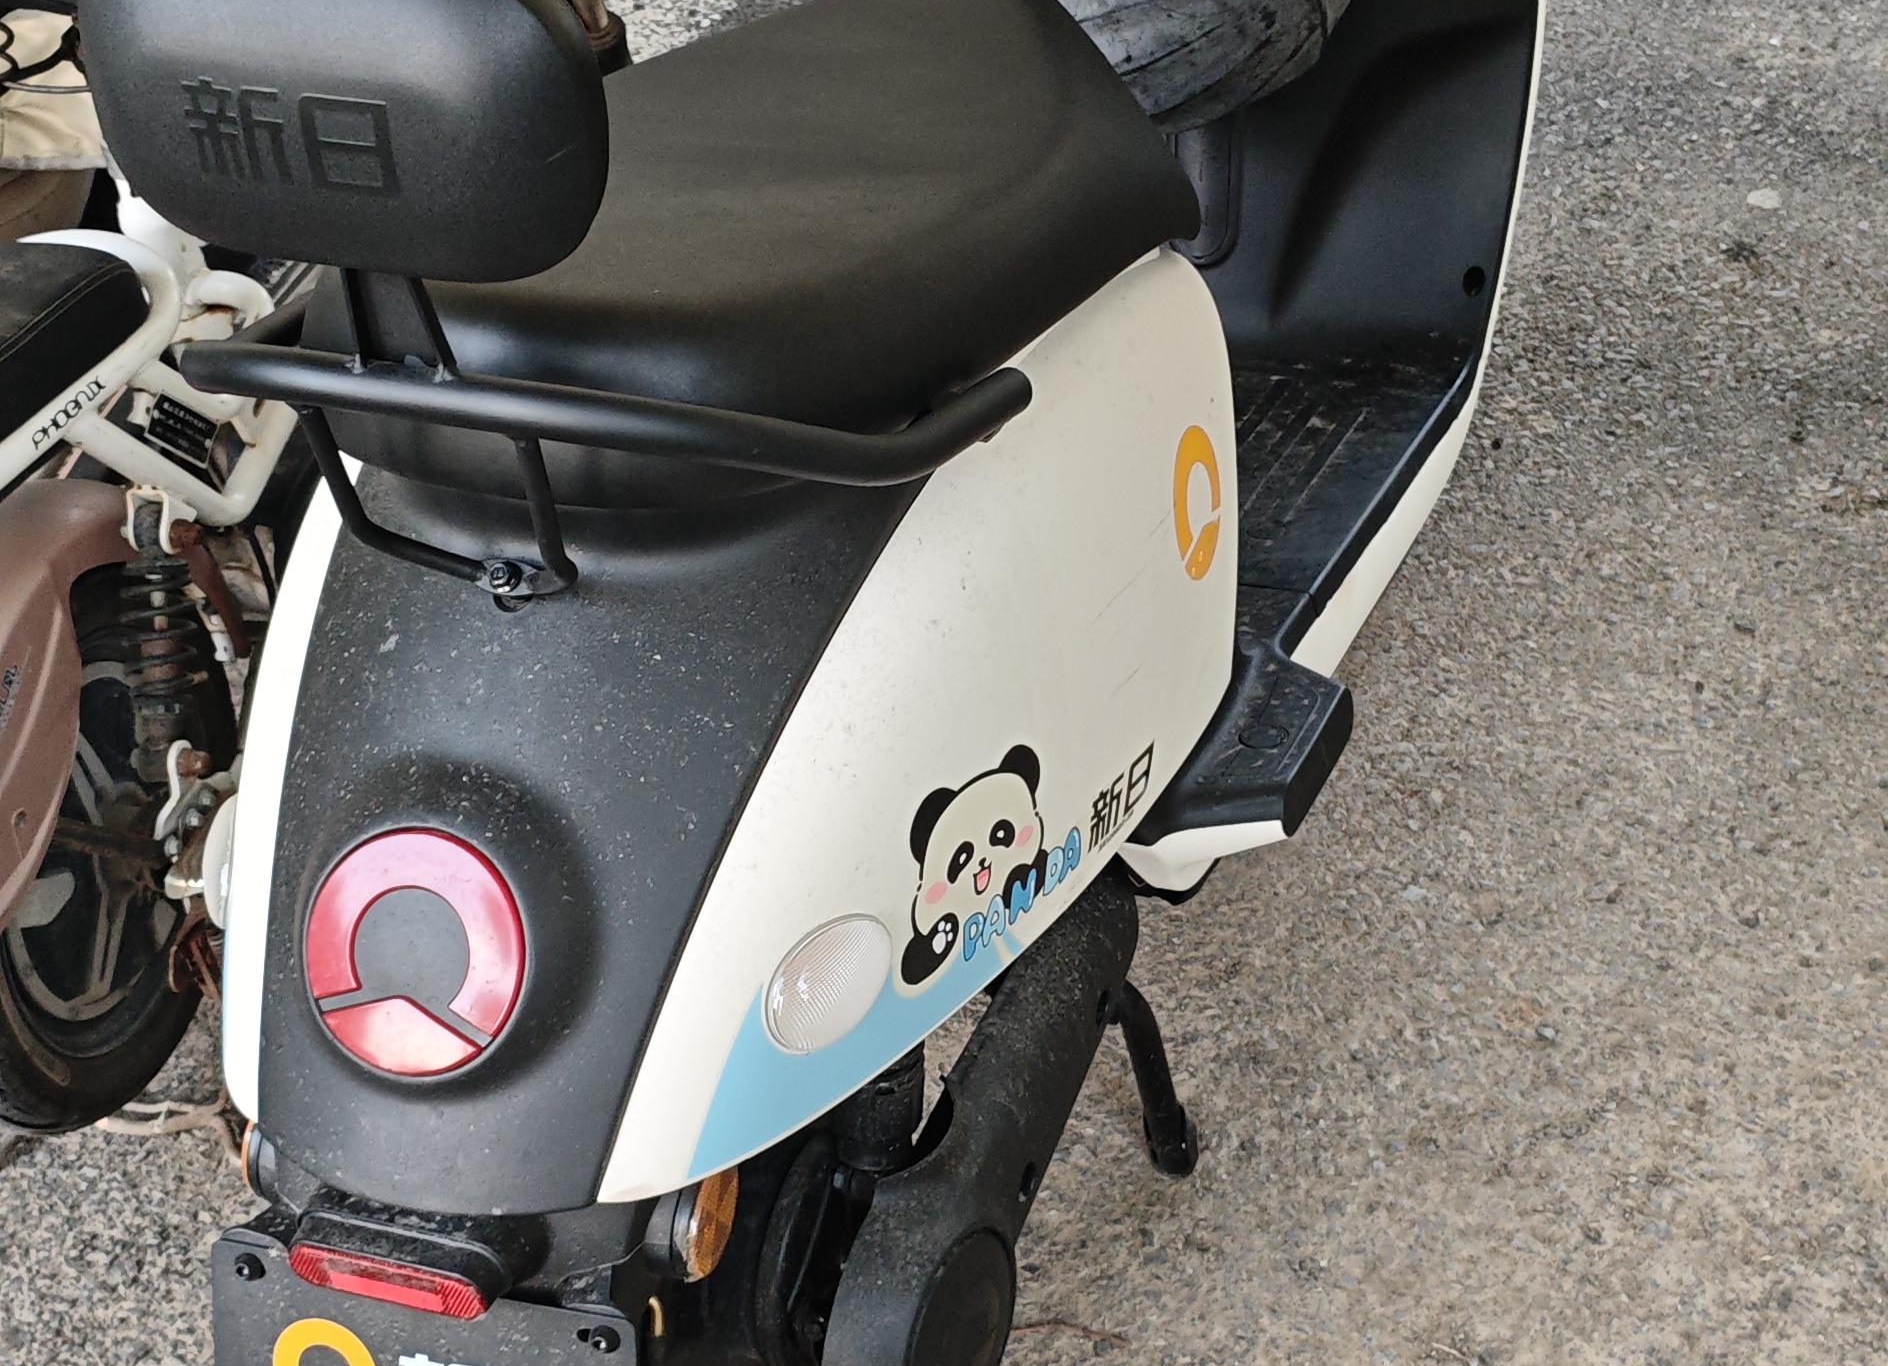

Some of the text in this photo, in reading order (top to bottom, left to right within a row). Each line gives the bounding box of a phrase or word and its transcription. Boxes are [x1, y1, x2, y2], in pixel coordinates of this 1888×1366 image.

[180, 75, 400, 192] 新日
[1087, 739, 1155, 854] 新日
[962, 825, 1081, 962] PANDA
